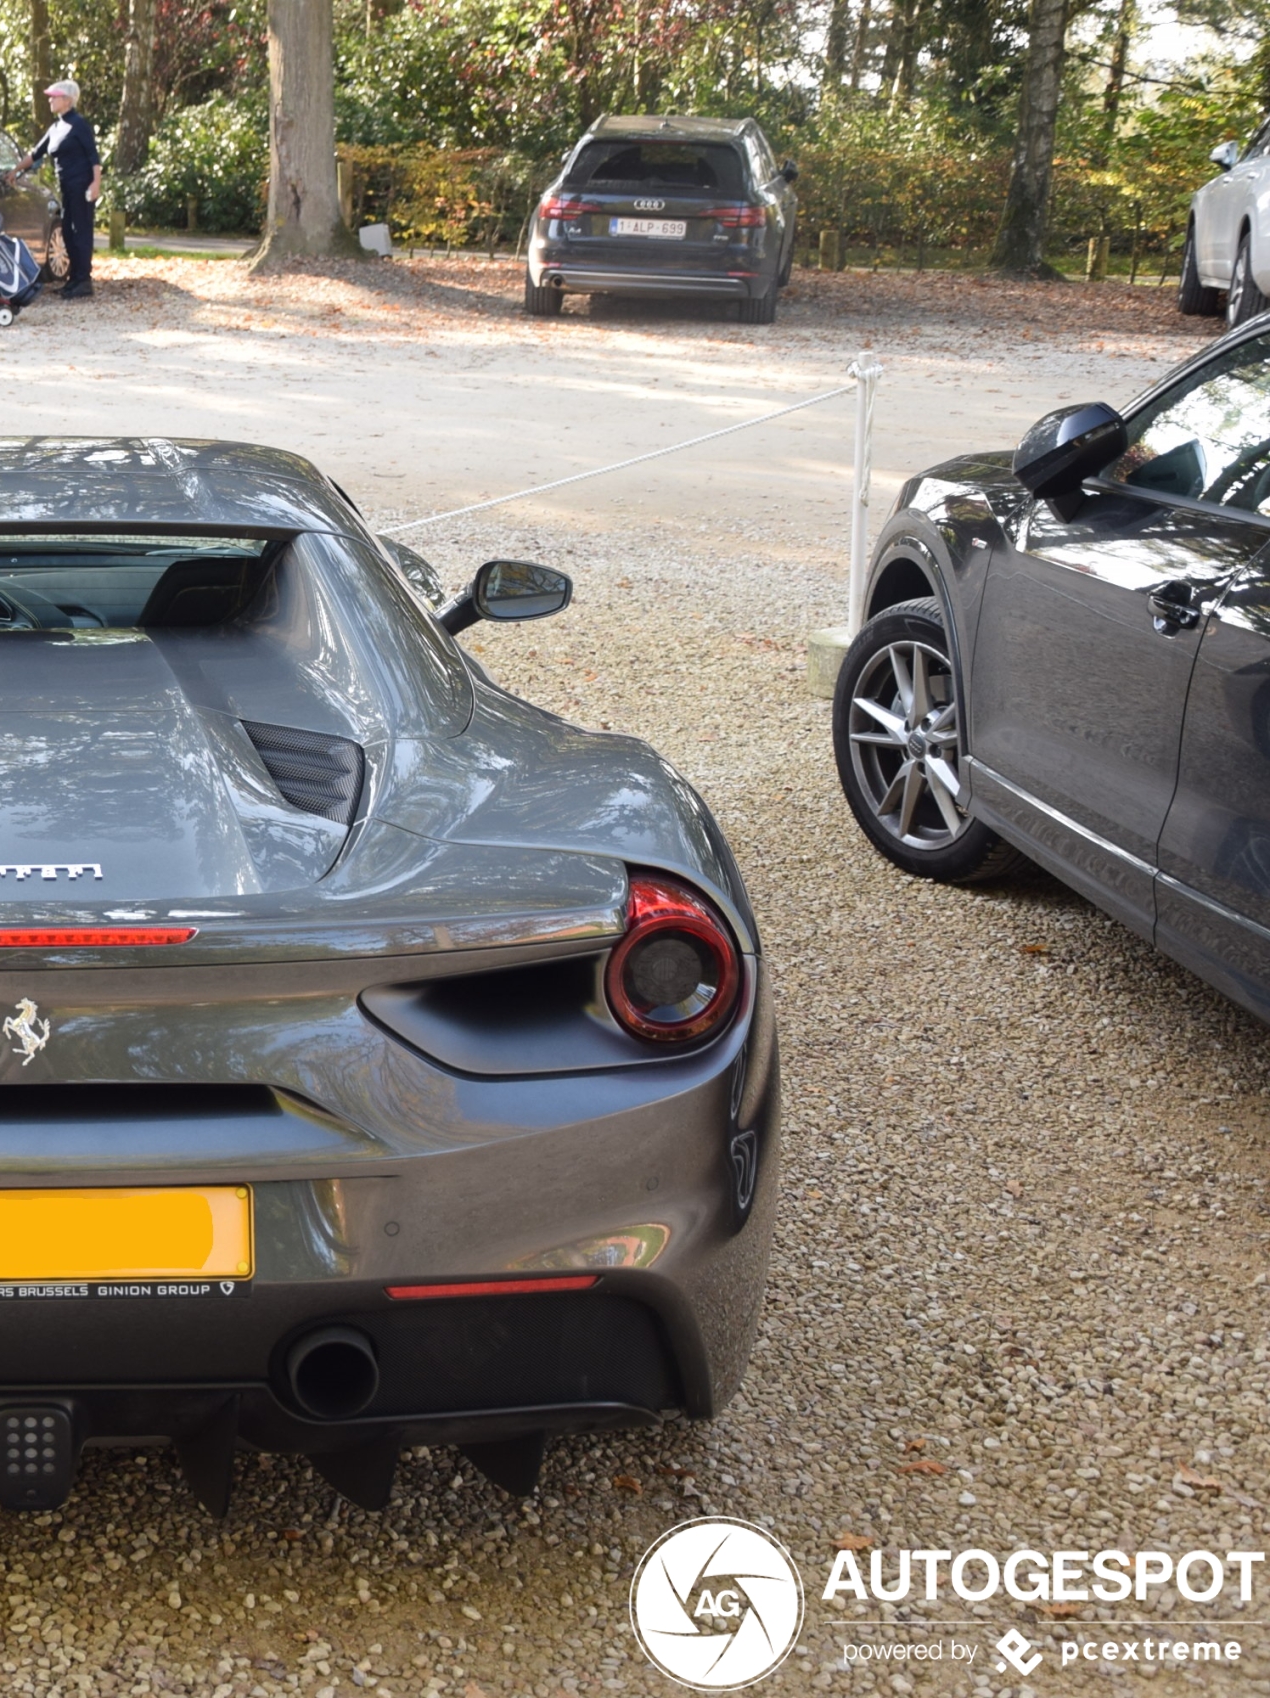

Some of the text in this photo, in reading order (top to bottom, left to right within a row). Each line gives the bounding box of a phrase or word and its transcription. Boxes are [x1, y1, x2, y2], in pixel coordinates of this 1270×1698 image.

[619, 220, 684, 235] 1-ALP-699
[19, 1286, 88, 1297] BRUSSELS
[98, 1286, 151, 1296] GINION
[157, 1285, 210, 1295] GROUP
